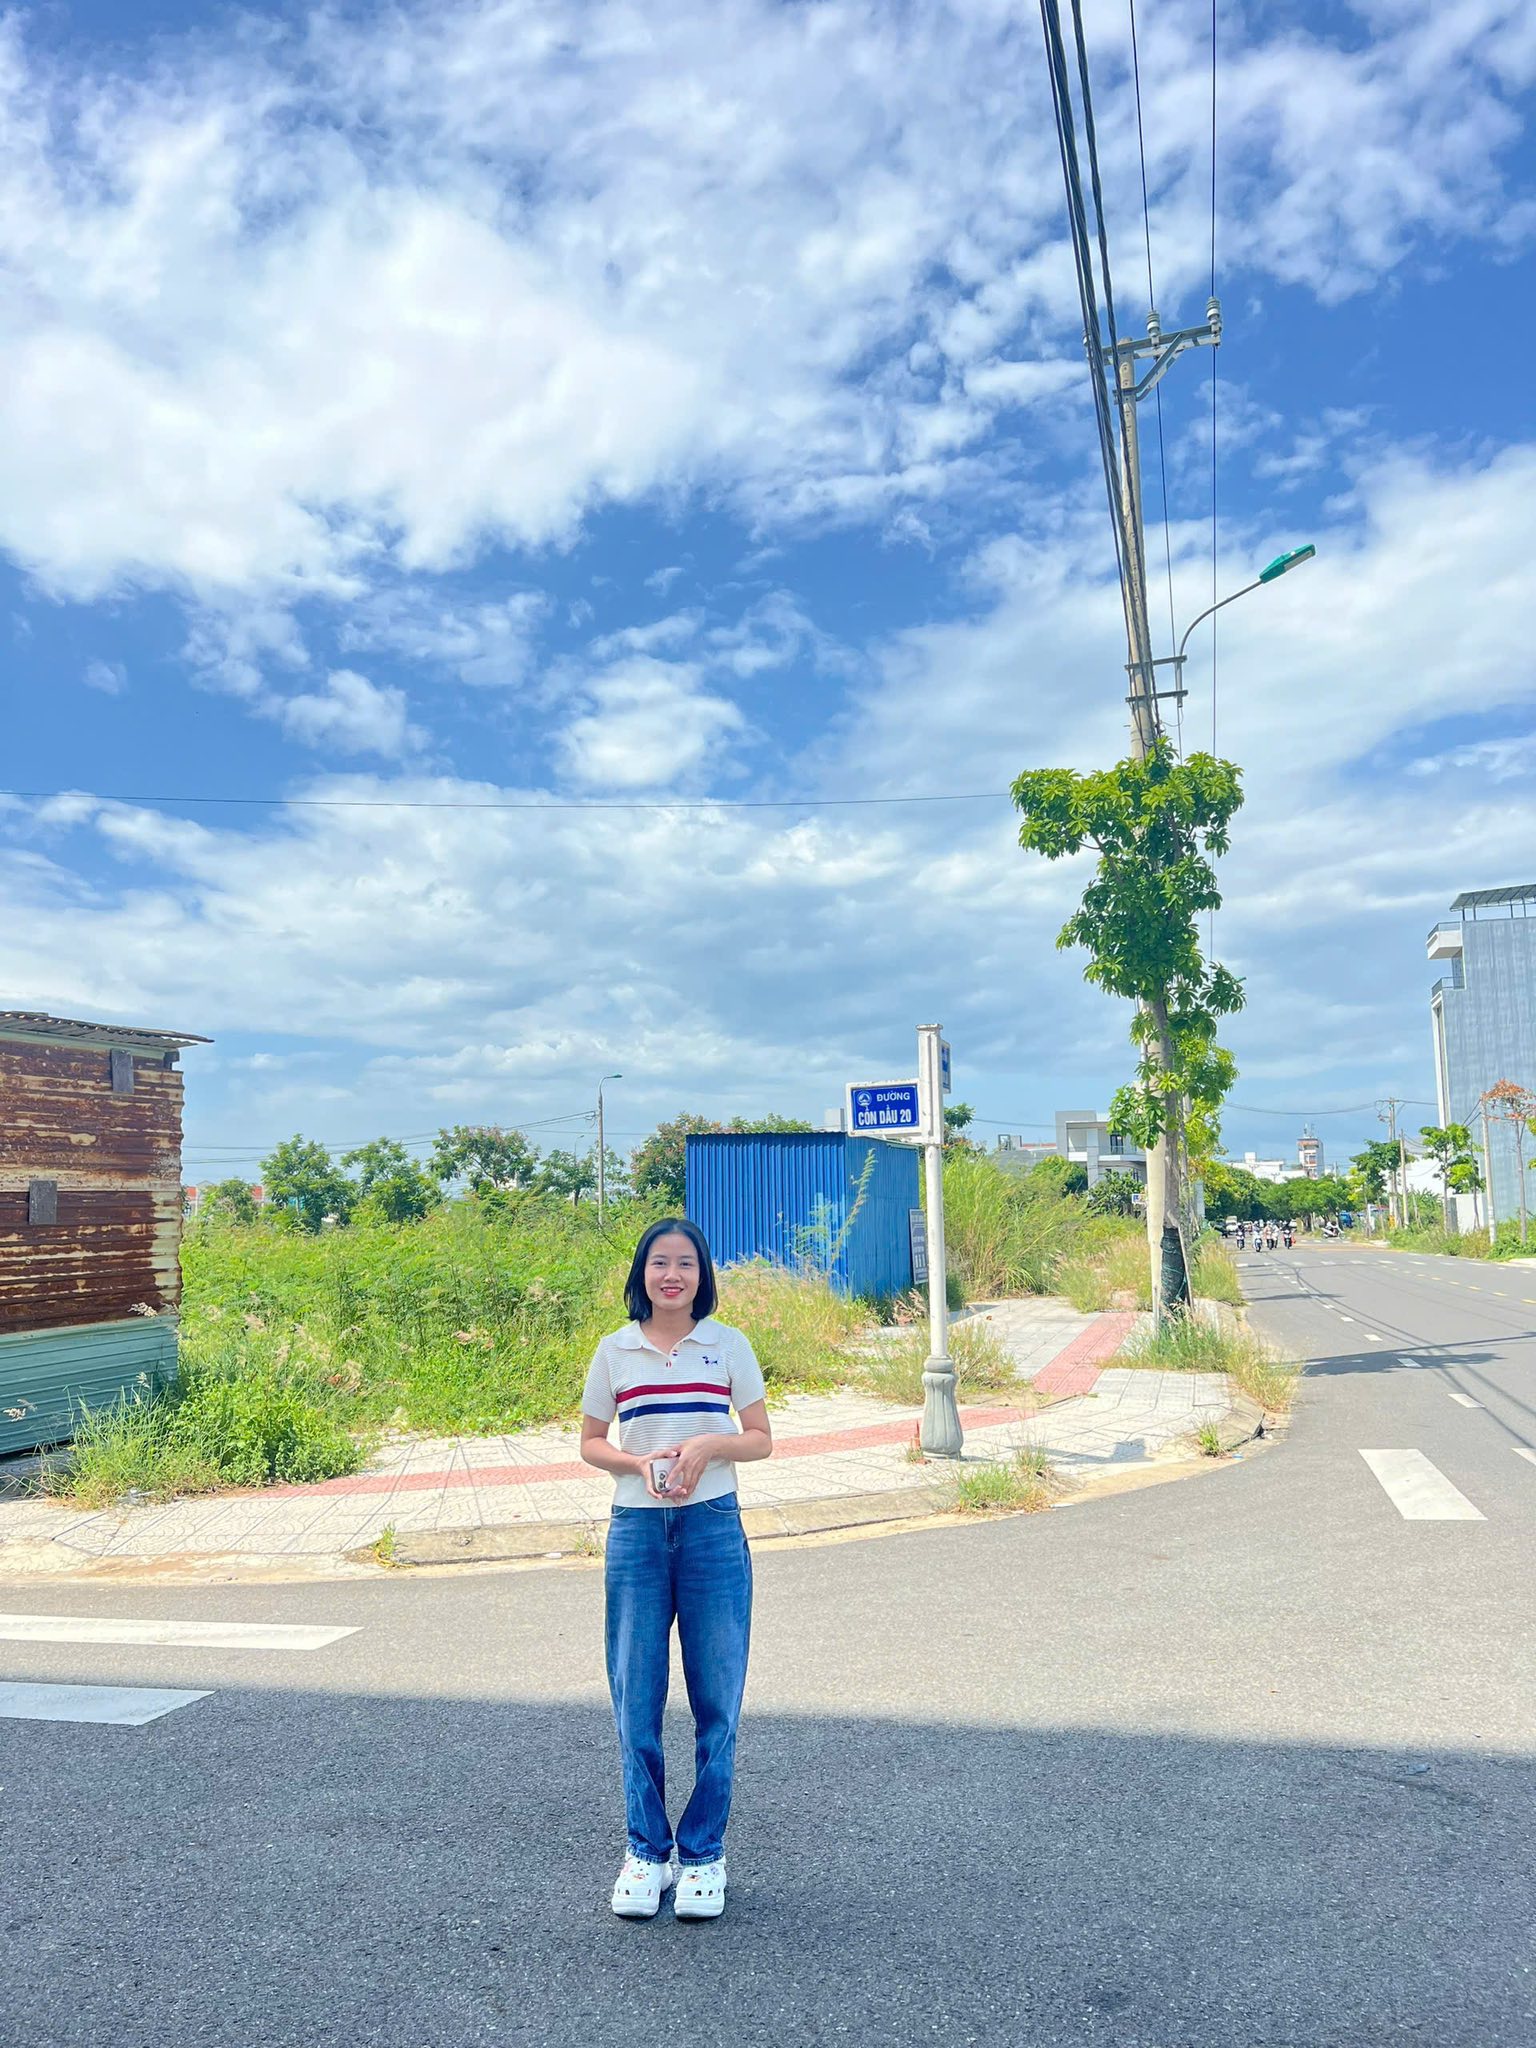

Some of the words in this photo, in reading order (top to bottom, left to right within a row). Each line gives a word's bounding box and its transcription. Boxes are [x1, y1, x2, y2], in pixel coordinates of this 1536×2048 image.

[876, 1090, 911, 1102] ĐƯỜNG
[879, 1104, 898, 1125] DẦU
[900, 1108, 912, 1123] 20
